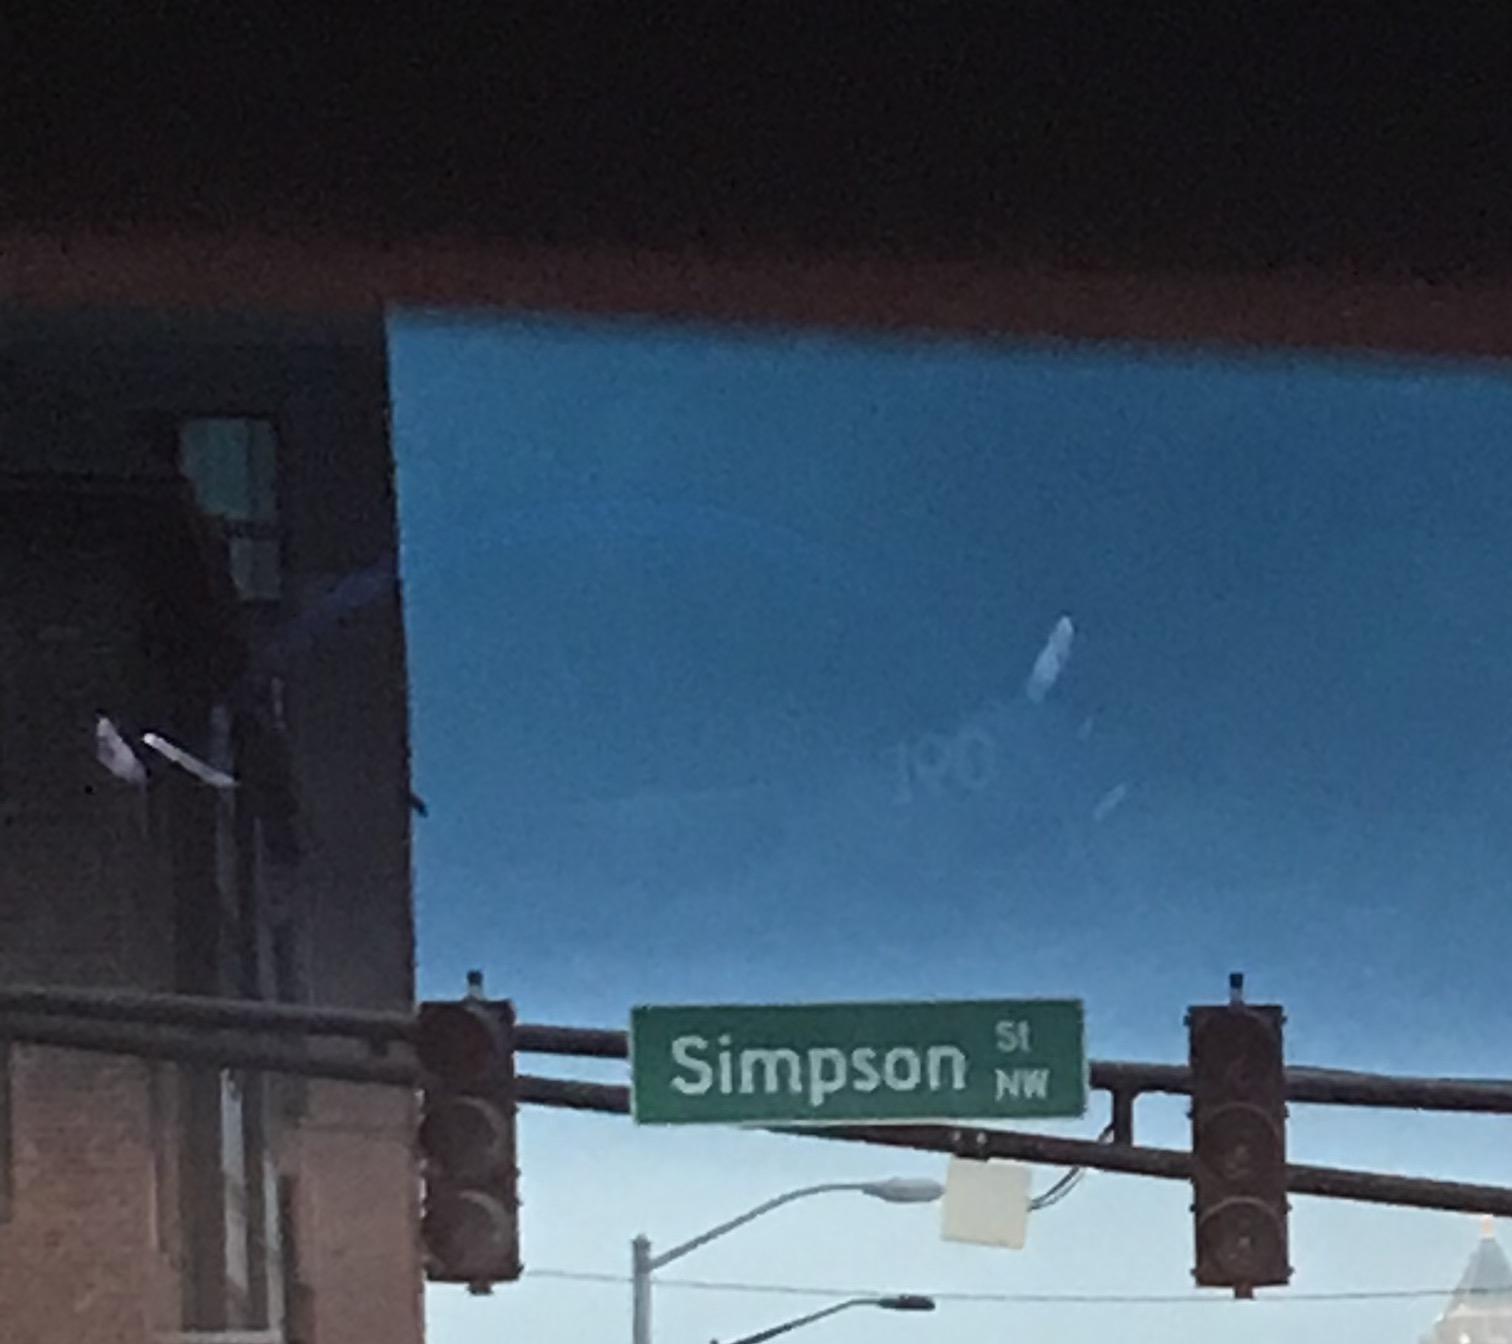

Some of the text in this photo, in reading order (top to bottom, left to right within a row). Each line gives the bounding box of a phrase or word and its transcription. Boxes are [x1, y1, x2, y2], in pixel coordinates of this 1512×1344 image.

[994, 1020, 1030, 1052] St
[670, 1034, 967, 1105] Simpson
[994, 1067, 1051, 1102] NW
